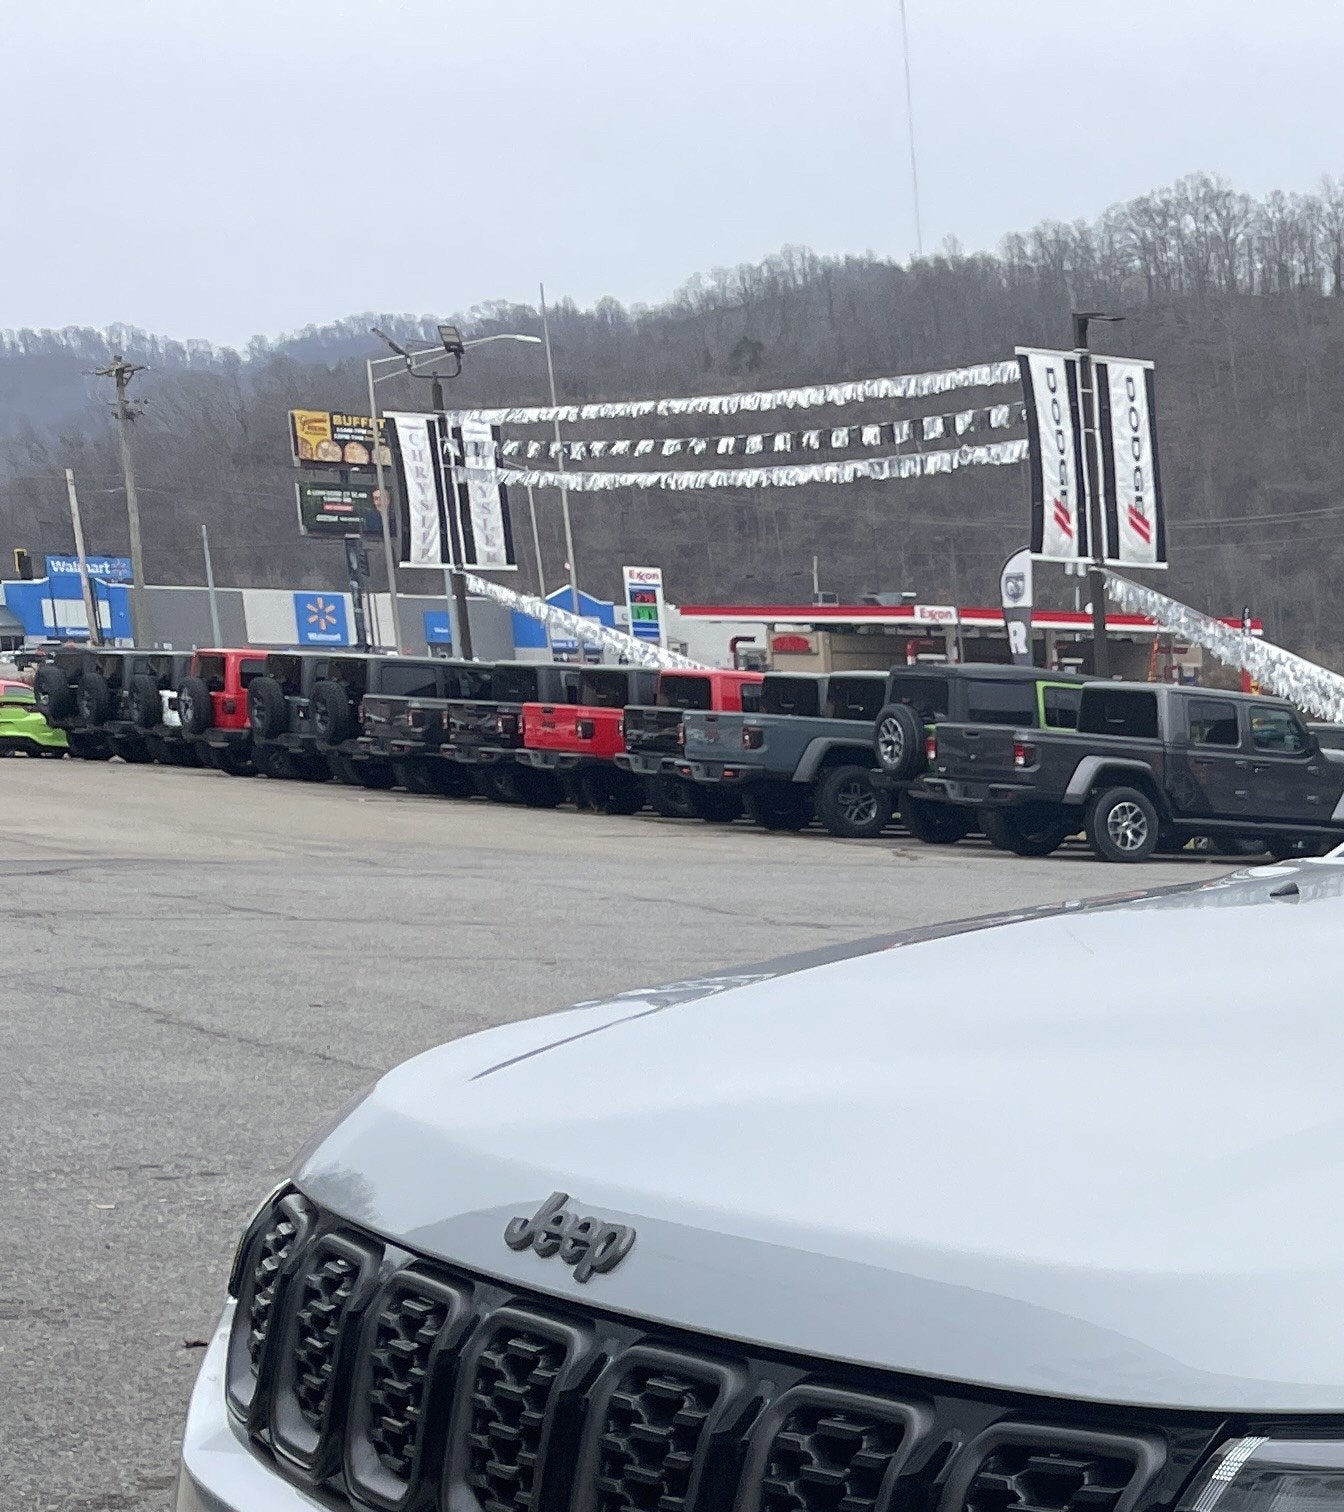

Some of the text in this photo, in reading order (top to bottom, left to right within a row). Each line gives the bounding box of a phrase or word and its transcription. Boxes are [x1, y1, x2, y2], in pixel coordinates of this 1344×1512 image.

[1046, 367, 1069, 513] DODGE
[1126, 376, 1144, 516] DODGE
[628, 569, 660, 584] Exxon
[503, 1190, 637, 1285] Jeep
